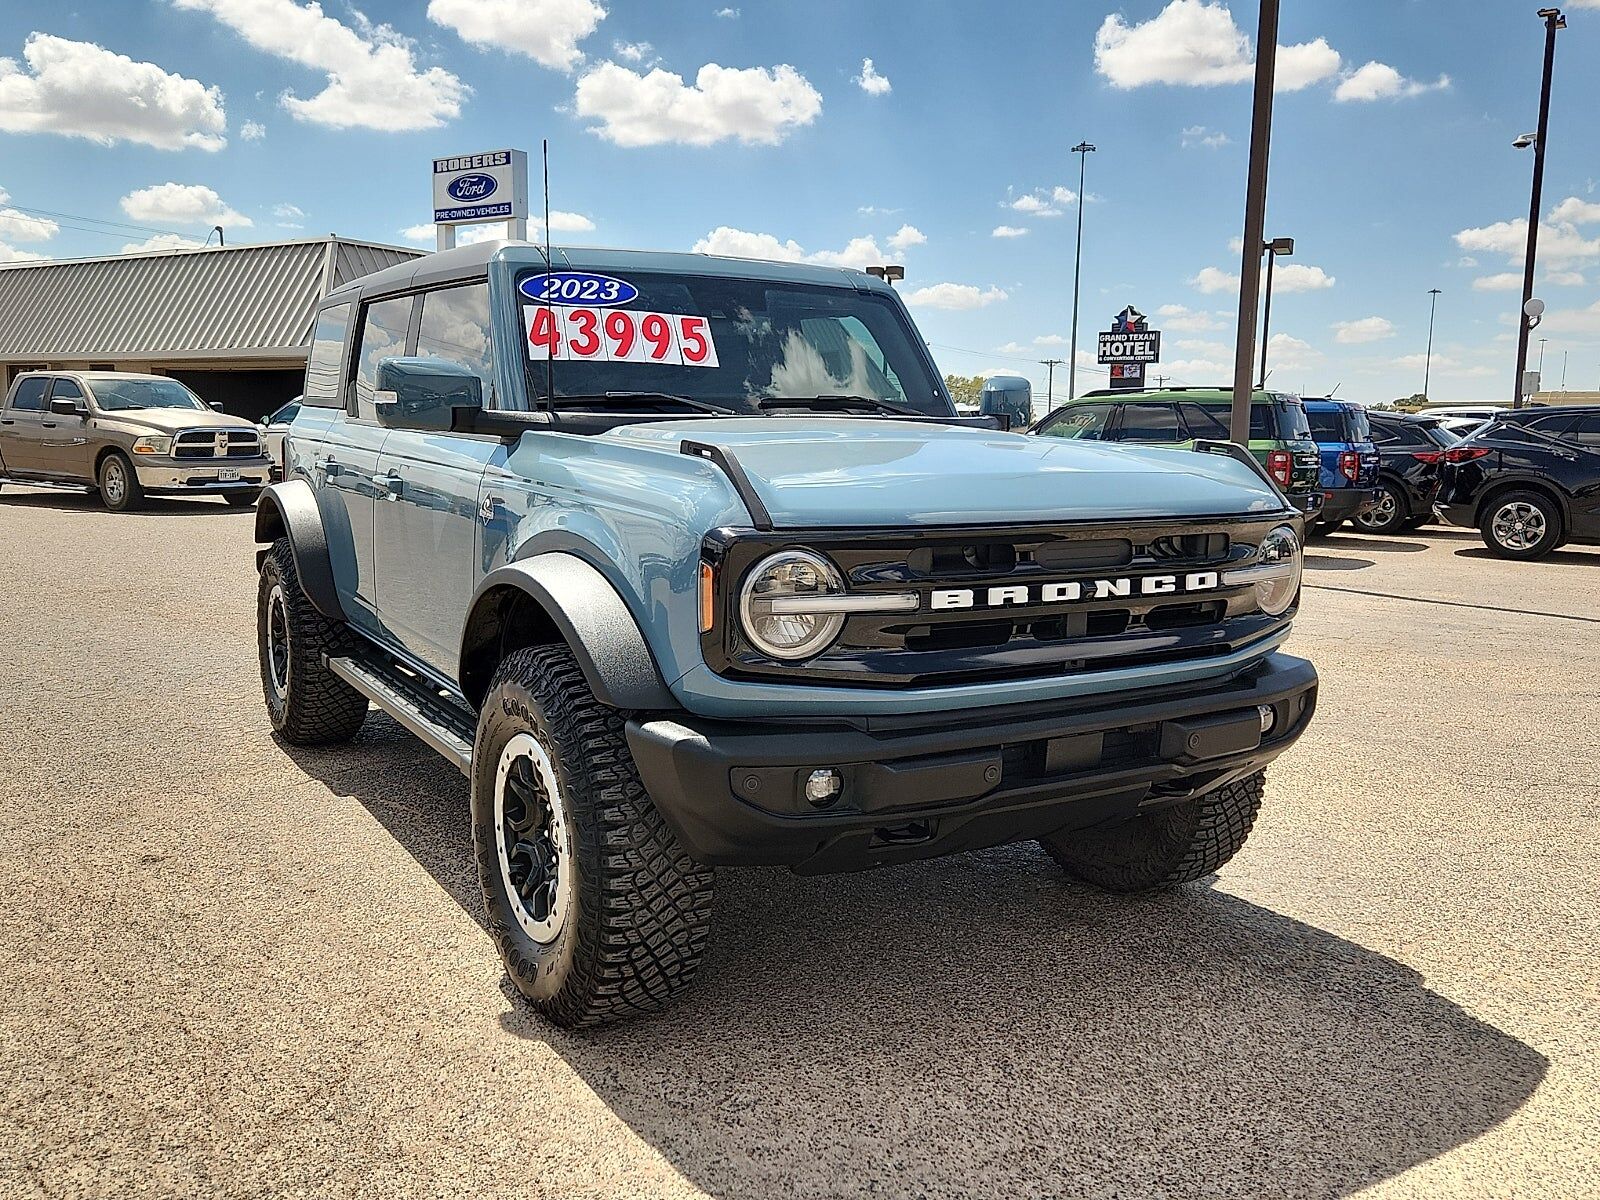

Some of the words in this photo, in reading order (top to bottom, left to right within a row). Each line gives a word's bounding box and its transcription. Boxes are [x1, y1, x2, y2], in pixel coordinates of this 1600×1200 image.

[436, 152, 507, 172] ROGERS
[456, 177, 486, 196] Ford
[436, 209, 476, 219] PRE-OWNED
[477, 205, 510, 215] VEHICLES
[539, 279, 621, 300] 2023
[528, 307, 712, 362] 43995
[1100, 334, 1127, 342] GRAND
[1099, 342, 1154, 356] HOTEL
[931, 571, 1218, 609] BRONCO
